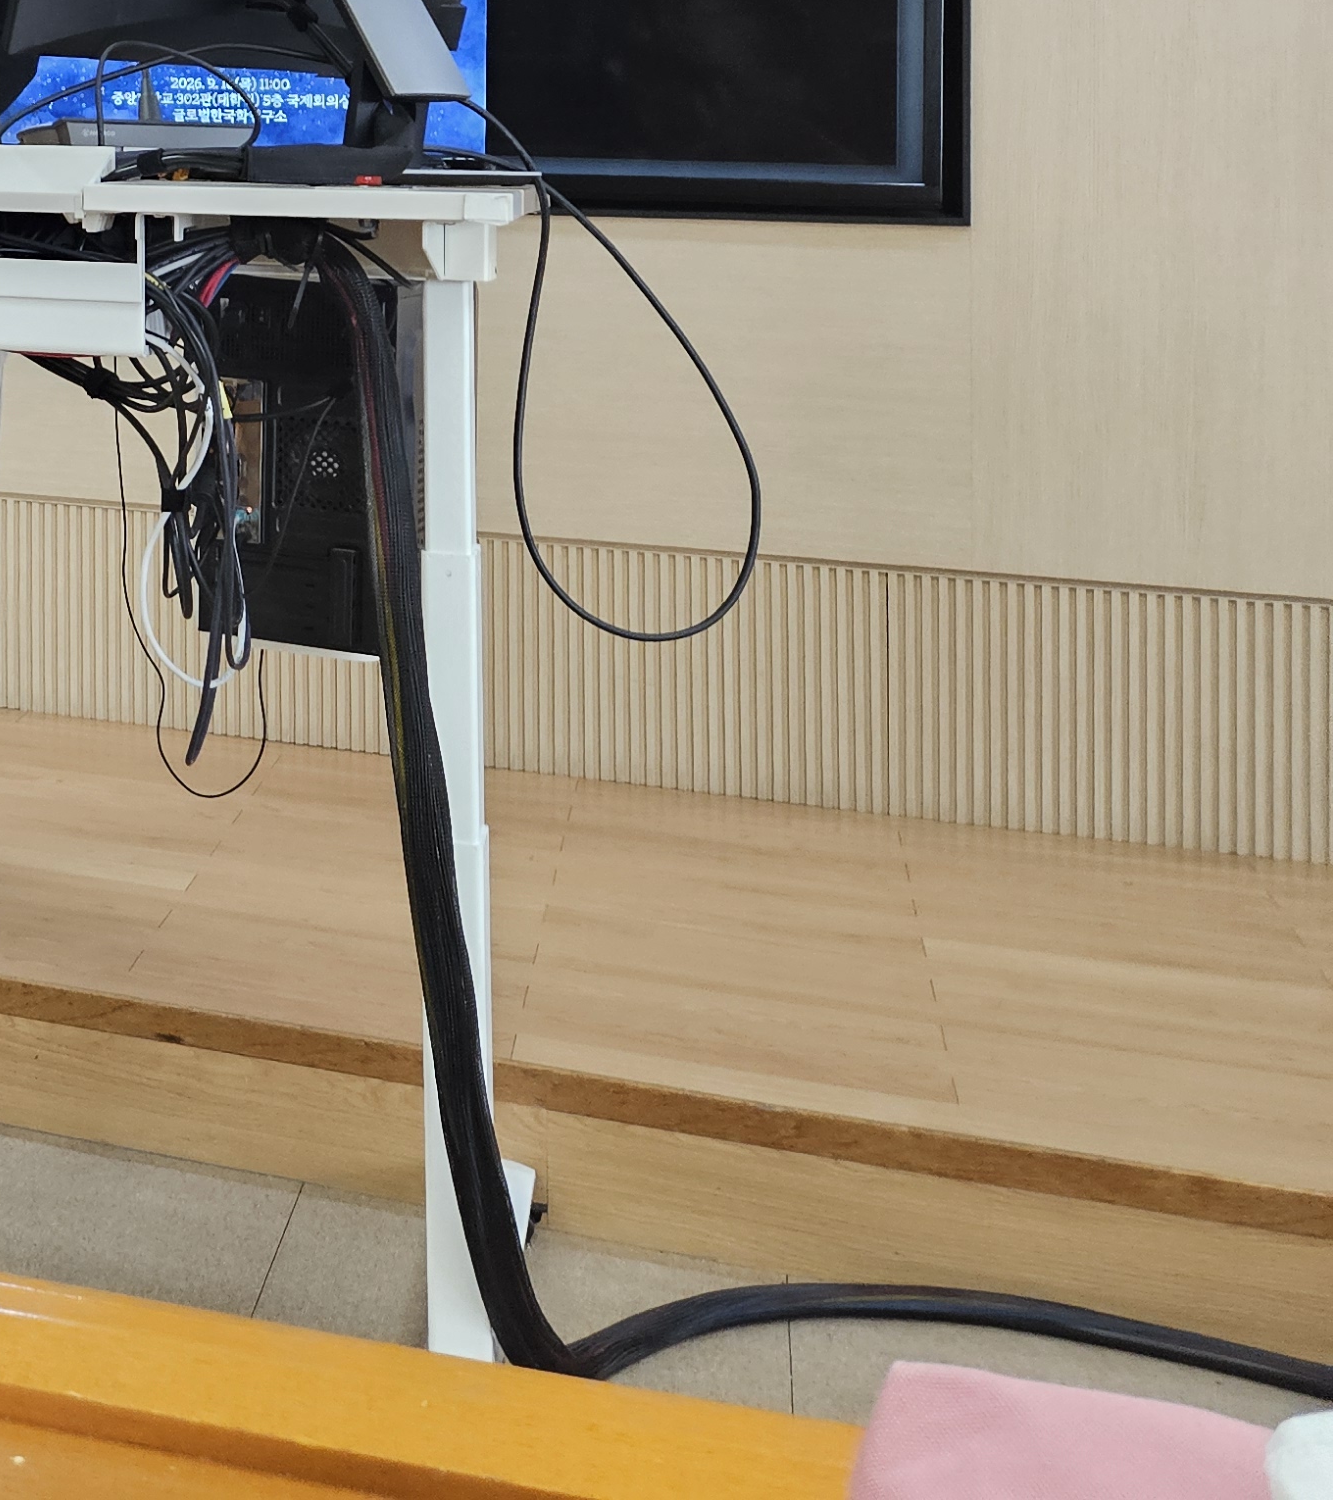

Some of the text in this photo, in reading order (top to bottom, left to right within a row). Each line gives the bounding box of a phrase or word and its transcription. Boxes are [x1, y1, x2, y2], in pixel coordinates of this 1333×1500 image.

[170, 77, 205, 90] 2026.
[259, 77, 291, 91] 11:00
[111, 91, 174, 106] 중앙교
[176, 91, 260, 108] 302관(대학)
[262, 93, 284, 108] 5층
